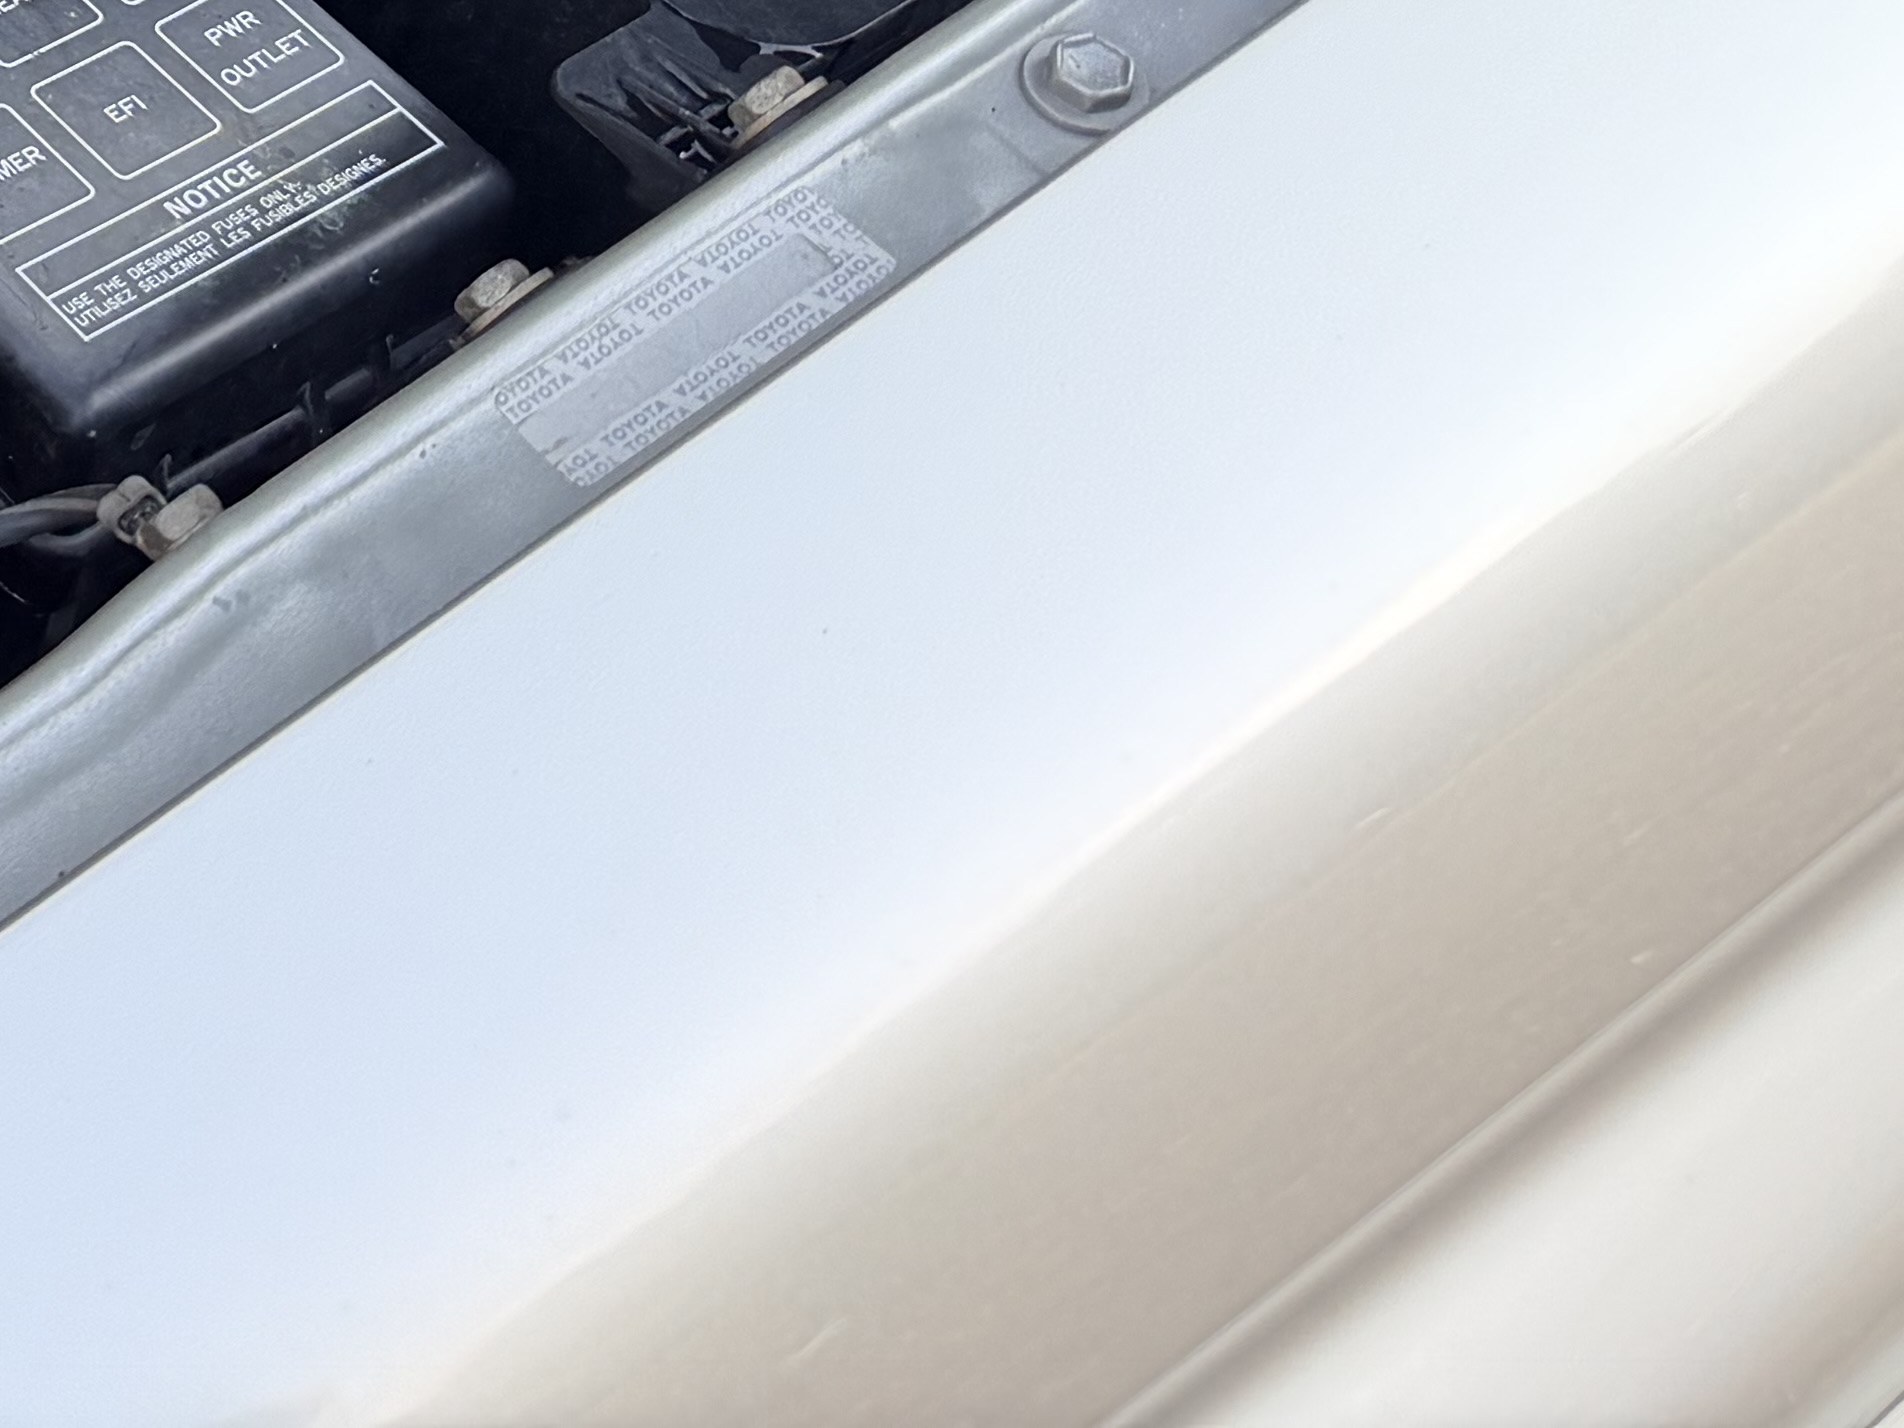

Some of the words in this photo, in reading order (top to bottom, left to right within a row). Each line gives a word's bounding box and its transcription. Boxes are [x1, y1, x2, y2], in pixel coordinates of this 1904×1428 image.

[203, 10, 262, 47] PWR
[220, 29, 310, 88] OUTLET
[103, 95, 148, 125] EFI
[162, 159, 263, 220] NOTICE
[62, 291, 95, 316] USE
[95, 274, 127, 295] THE
[126, 230, 211, 281] DESIGNATED
[211, 204, 254, 234] FUSES
[74, 290, 137, 328] UTILISEZ
[138, 246, 221, 294] SEULEMENT
[221, 225, 252, 249] LES
[252, 191, 316, 233] FUSIBLES
[507, 374, 573, 419] TOYOTA
[578, 325, 643, 370] TOYOTA
[648, 277, 712, 323] TOYOTA
[720, 230, 782, 274] TOYOTA
[601, 403, 665, 448] TOYOTA
[742, 304, 807, 350] TOYOTA
